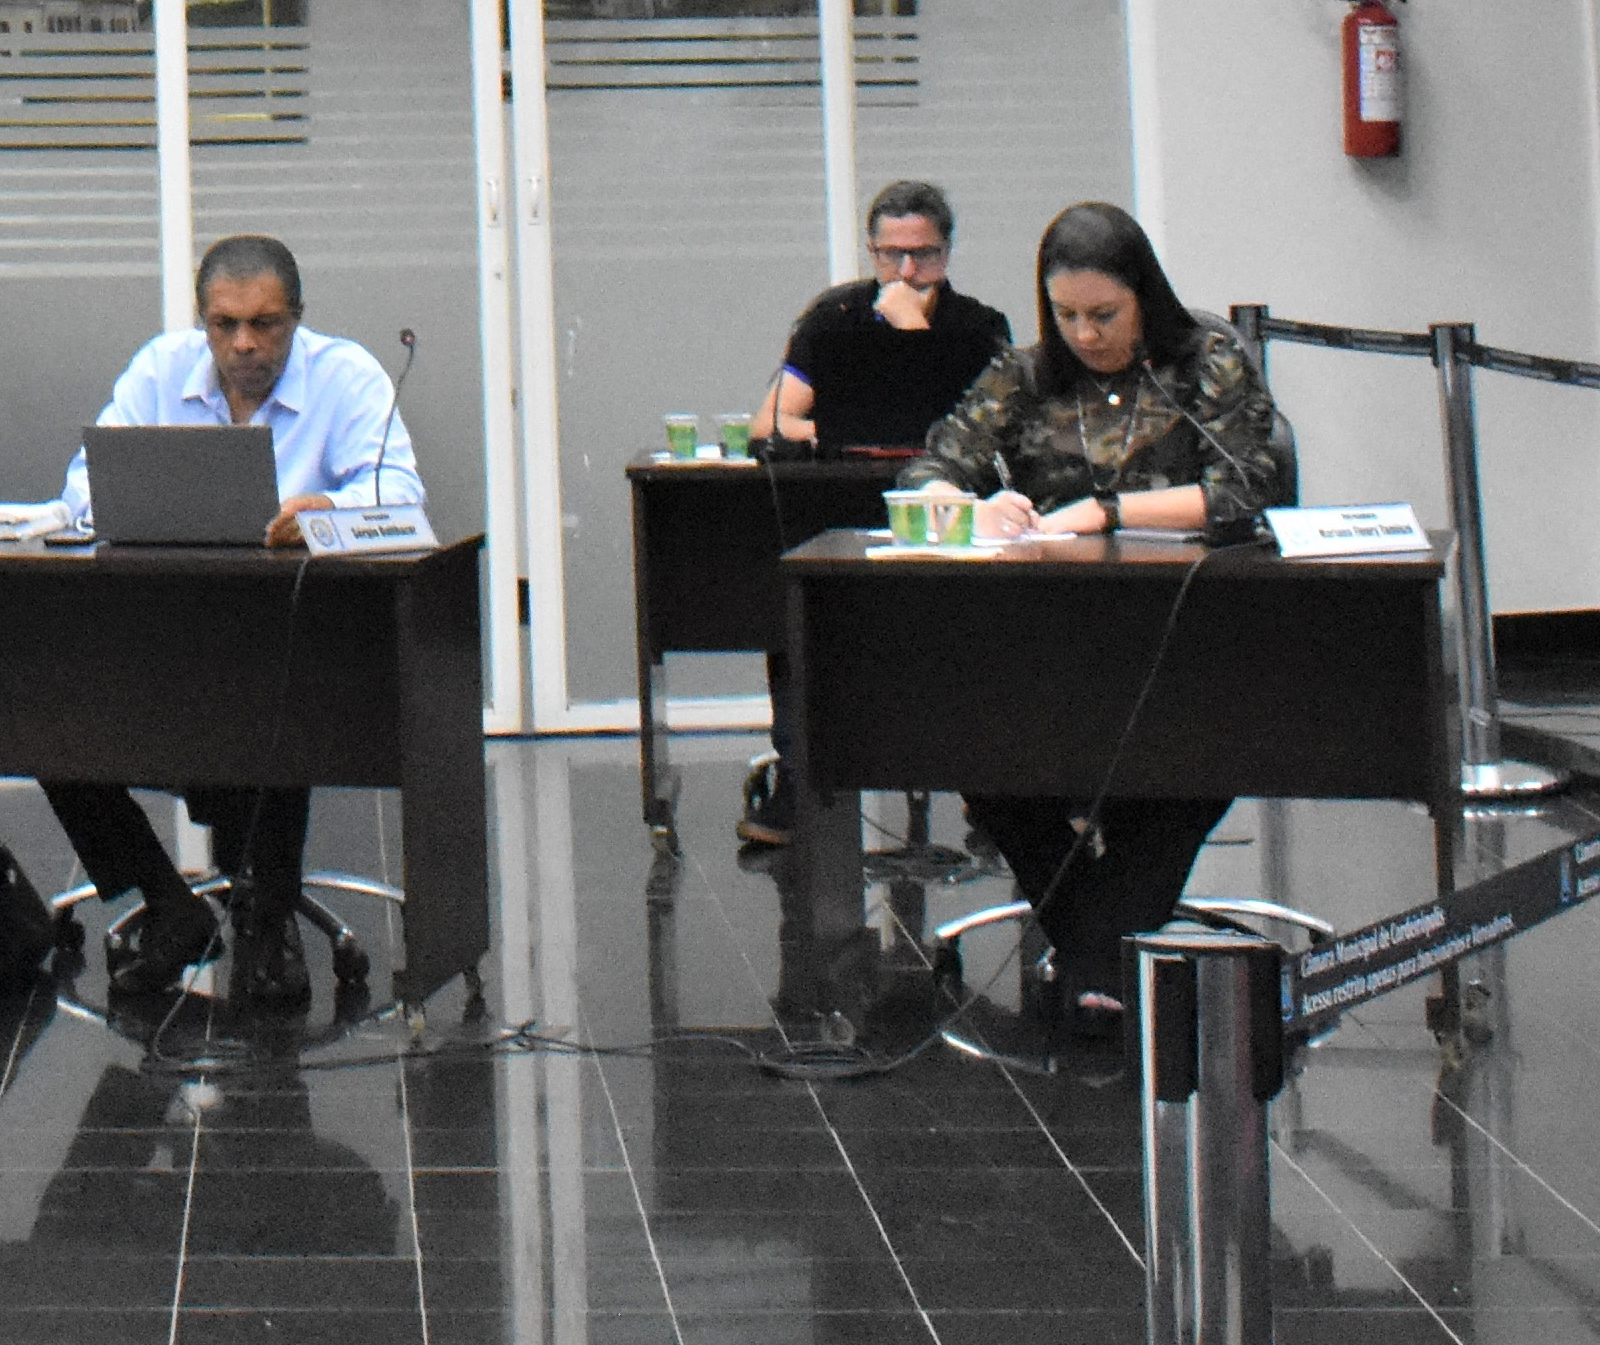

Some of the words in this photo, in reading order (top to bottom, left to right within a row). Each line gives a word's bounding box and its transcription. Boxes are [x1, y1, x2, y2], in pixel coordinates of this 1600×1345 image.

[1336, 929, 1378, 962] Municipal
[1377, 927, 1390, 948] de
[1302, 990, 1333, 1015] Acesso
[1333, 977, 1366, 1008] restrito
